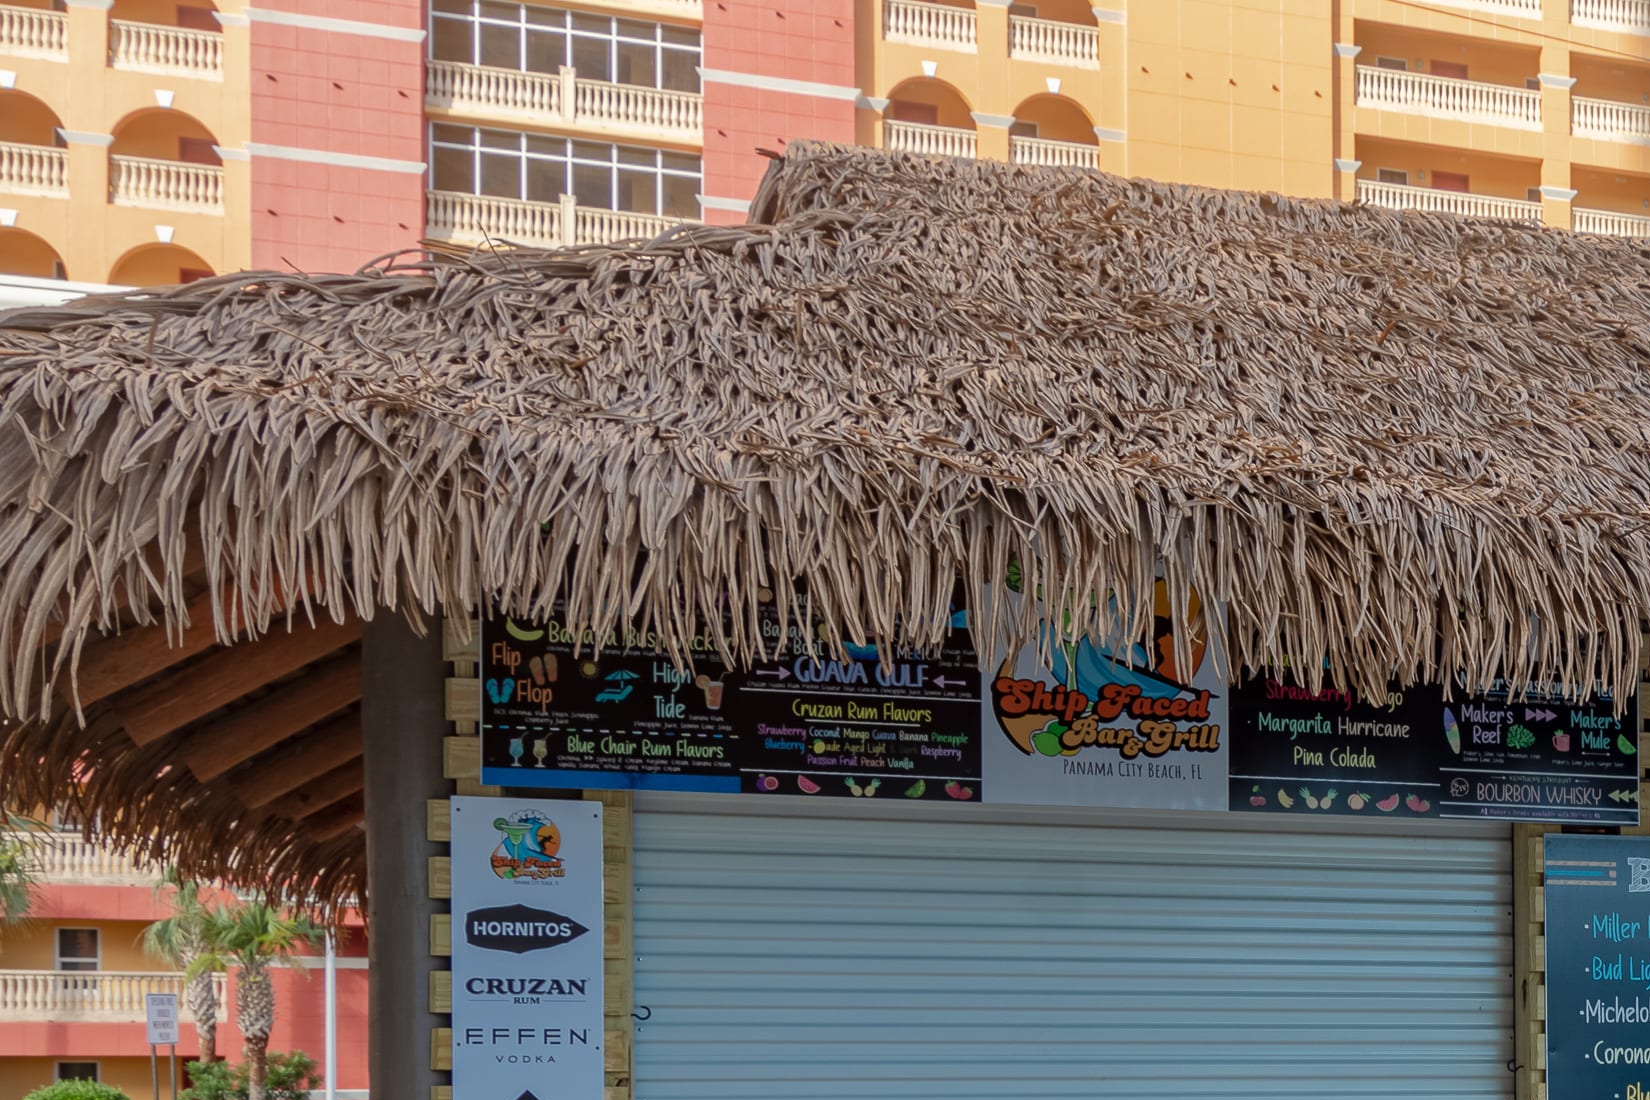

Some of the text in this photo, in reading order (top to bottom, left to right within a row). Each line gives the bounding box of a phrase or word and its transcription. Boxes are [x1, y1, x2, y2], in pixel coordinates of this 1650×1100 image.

[548, 620, 618, 646] Baaa
[491, 640, 522, 676] Flip
[652, 660, 691, 692] High
[793, 656, 869, 684] GUAVA
[516, 679, 552, 712] Flop
[653, 695, 686, 719] Tide
[995, 676, 1088, 720] Ship
[1096, 683, 1210, 719] Faced
[792, 698, 932, 722] Cruzan Rum Flavors
[1461, 702, 1515, 725] Maker's
[1570, 709, 1622, 731] Maker's
[757, 723, 968, 745] Strawberry Coconut Mango Guava Banana Pineapple
[1062, 714, 1221, 756] Bar & Grill
[1258, 712, 1411, 740] Margarita Hurricane
[1472, 725, 1501, 745] Reef
[566, 735, 724, 758] Blue Chair Rum Flavors
[764, 738, 806, 754] Blueberry
[844, 742, 865, 754] Aged
[867, 742, 887, 754] Light
[921, 746, 961, 761] Raspberry
[1581, 731, 1611, 750] Mule
[807, 755, 915, 769] Passion Fruit Peach Vanilla
[1294, 745, 1376, 768] Pina Colada
[1063, 758, 1114, 777] PANAMA
[1118, 760, 1143, 778] CITY
[1191, 763, 1202, 780] FL
[1477, 782, 1602, 806] BOURBON WHISKY
[473, 921, 572, 938] HORNITOS
[1592, 912, 1640, 943] Miller
[1592, 953, 1622, 981] Bud
[465, 977, 587, 996] CRUZAN
[513, 997, 540, 1005] RUM
[466, 1028, 588, 1045] EFFEN
[496, 1055, 556, 1063] VODKA
